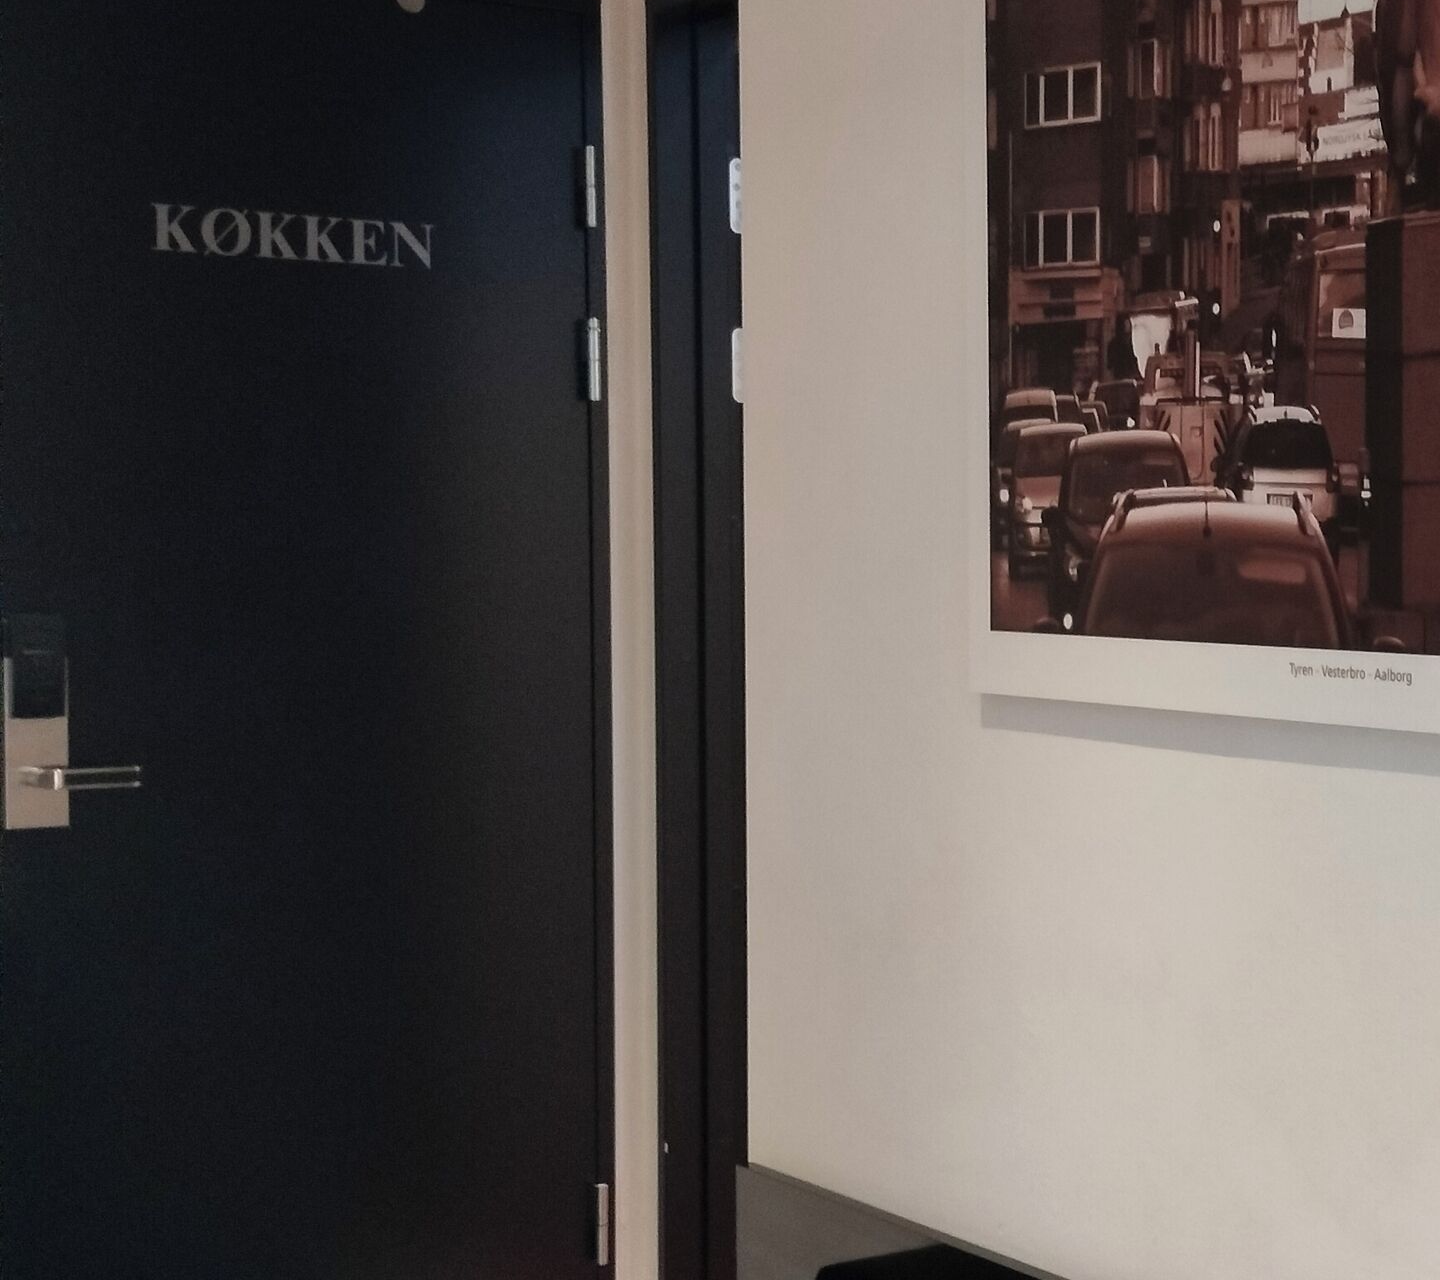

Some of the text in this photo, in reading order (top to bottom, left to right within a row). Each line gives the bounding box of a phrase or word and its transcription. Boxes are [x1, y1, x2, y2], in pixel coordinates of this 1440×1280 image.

[151, 202, 433, 269] KØKKEN
[1289, 662, 1413, 686] Tyren Vesterbro Aalborg
